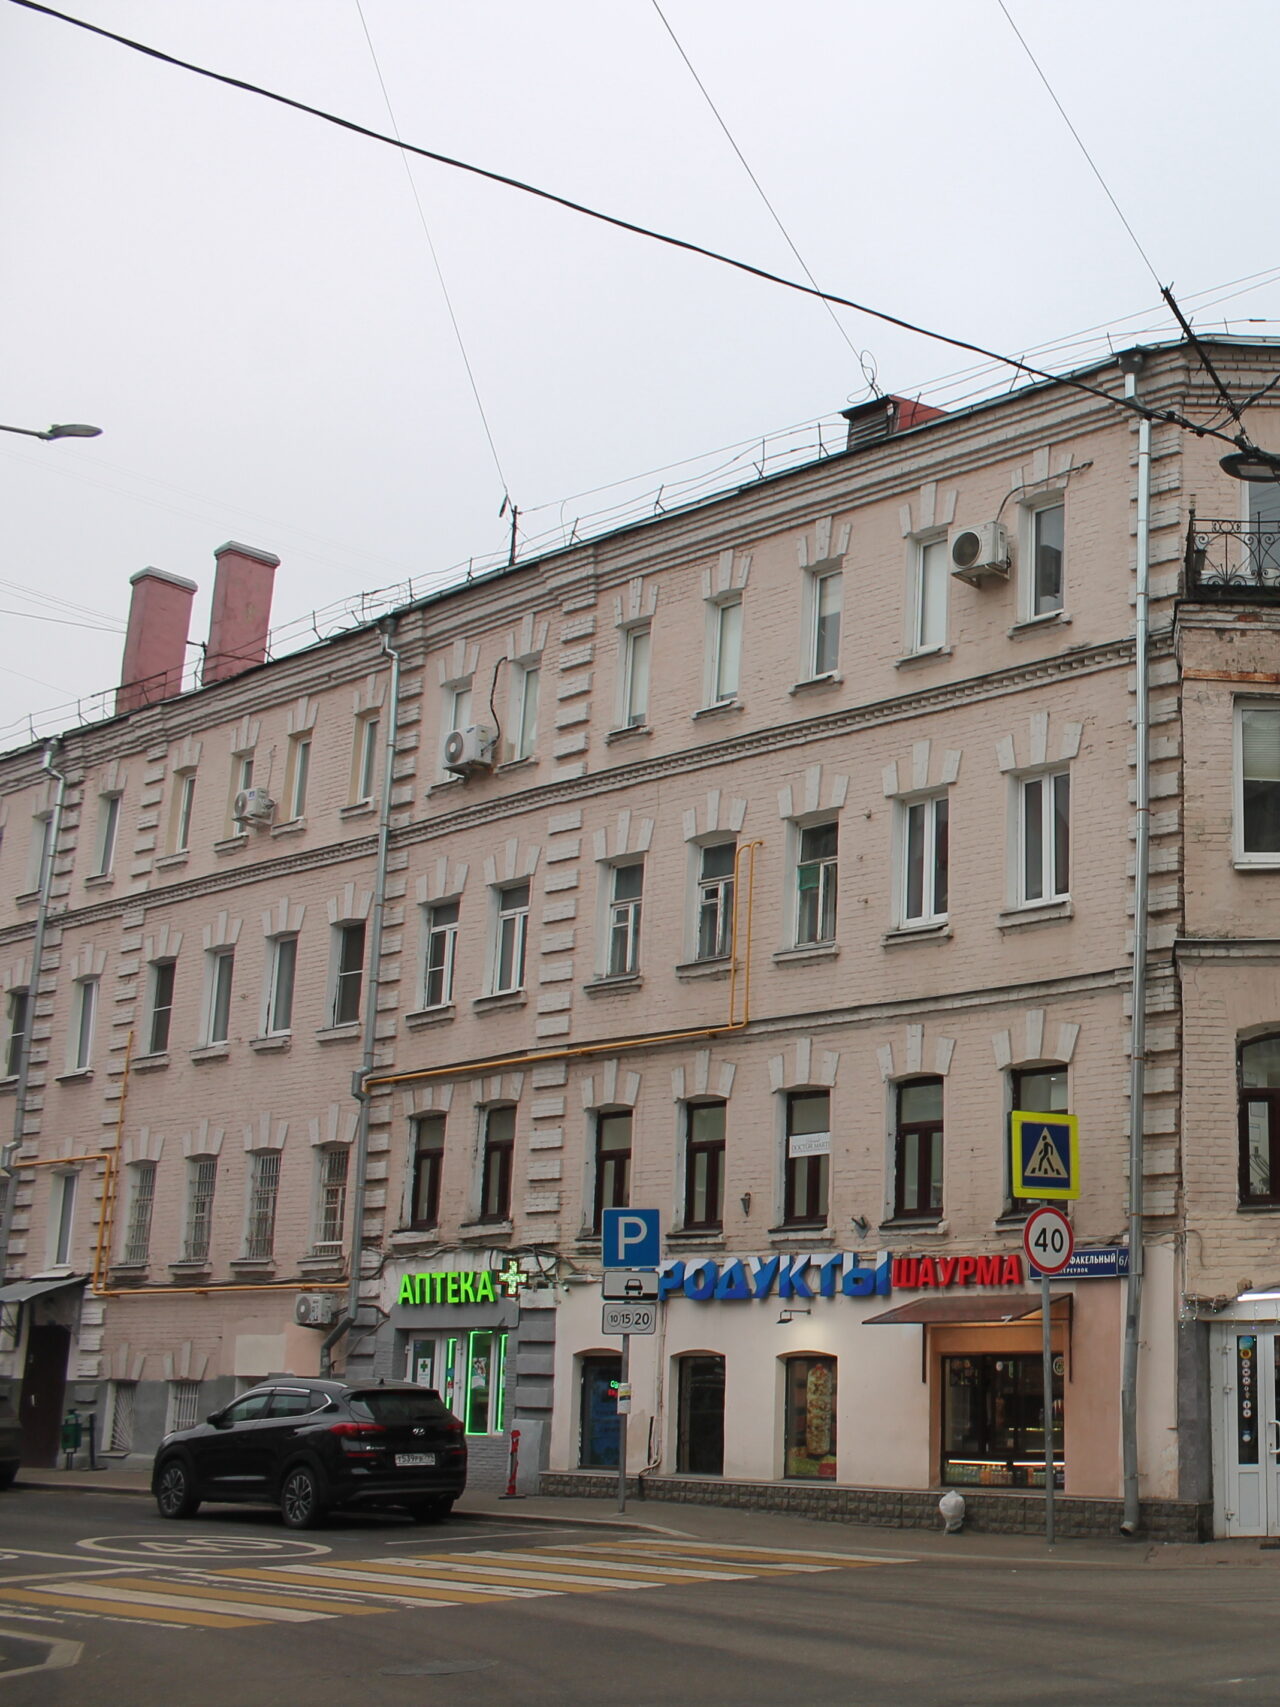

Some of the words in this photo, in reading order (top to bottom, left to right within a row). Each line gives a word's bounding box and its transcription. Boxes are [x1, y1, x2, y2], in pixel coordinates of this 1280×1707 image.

[617, 1216, 648, 1260] P
[1034, 1227, 1065, 1253] 40
[656, 1250, 893, 1301] РОДУКТЫ
[891, 1254, 1022, 1288] ШАУРМА
[1069, 1253, 1116, 1265] ФАКЕЛЬНЫЙ
[398, 1271, 495, 1304] АПТЕКА
[610, 1314, 619, 1323] 10
[621, 1313, 631, 1324] 15
[634, 1312, 650, 1325] 20
